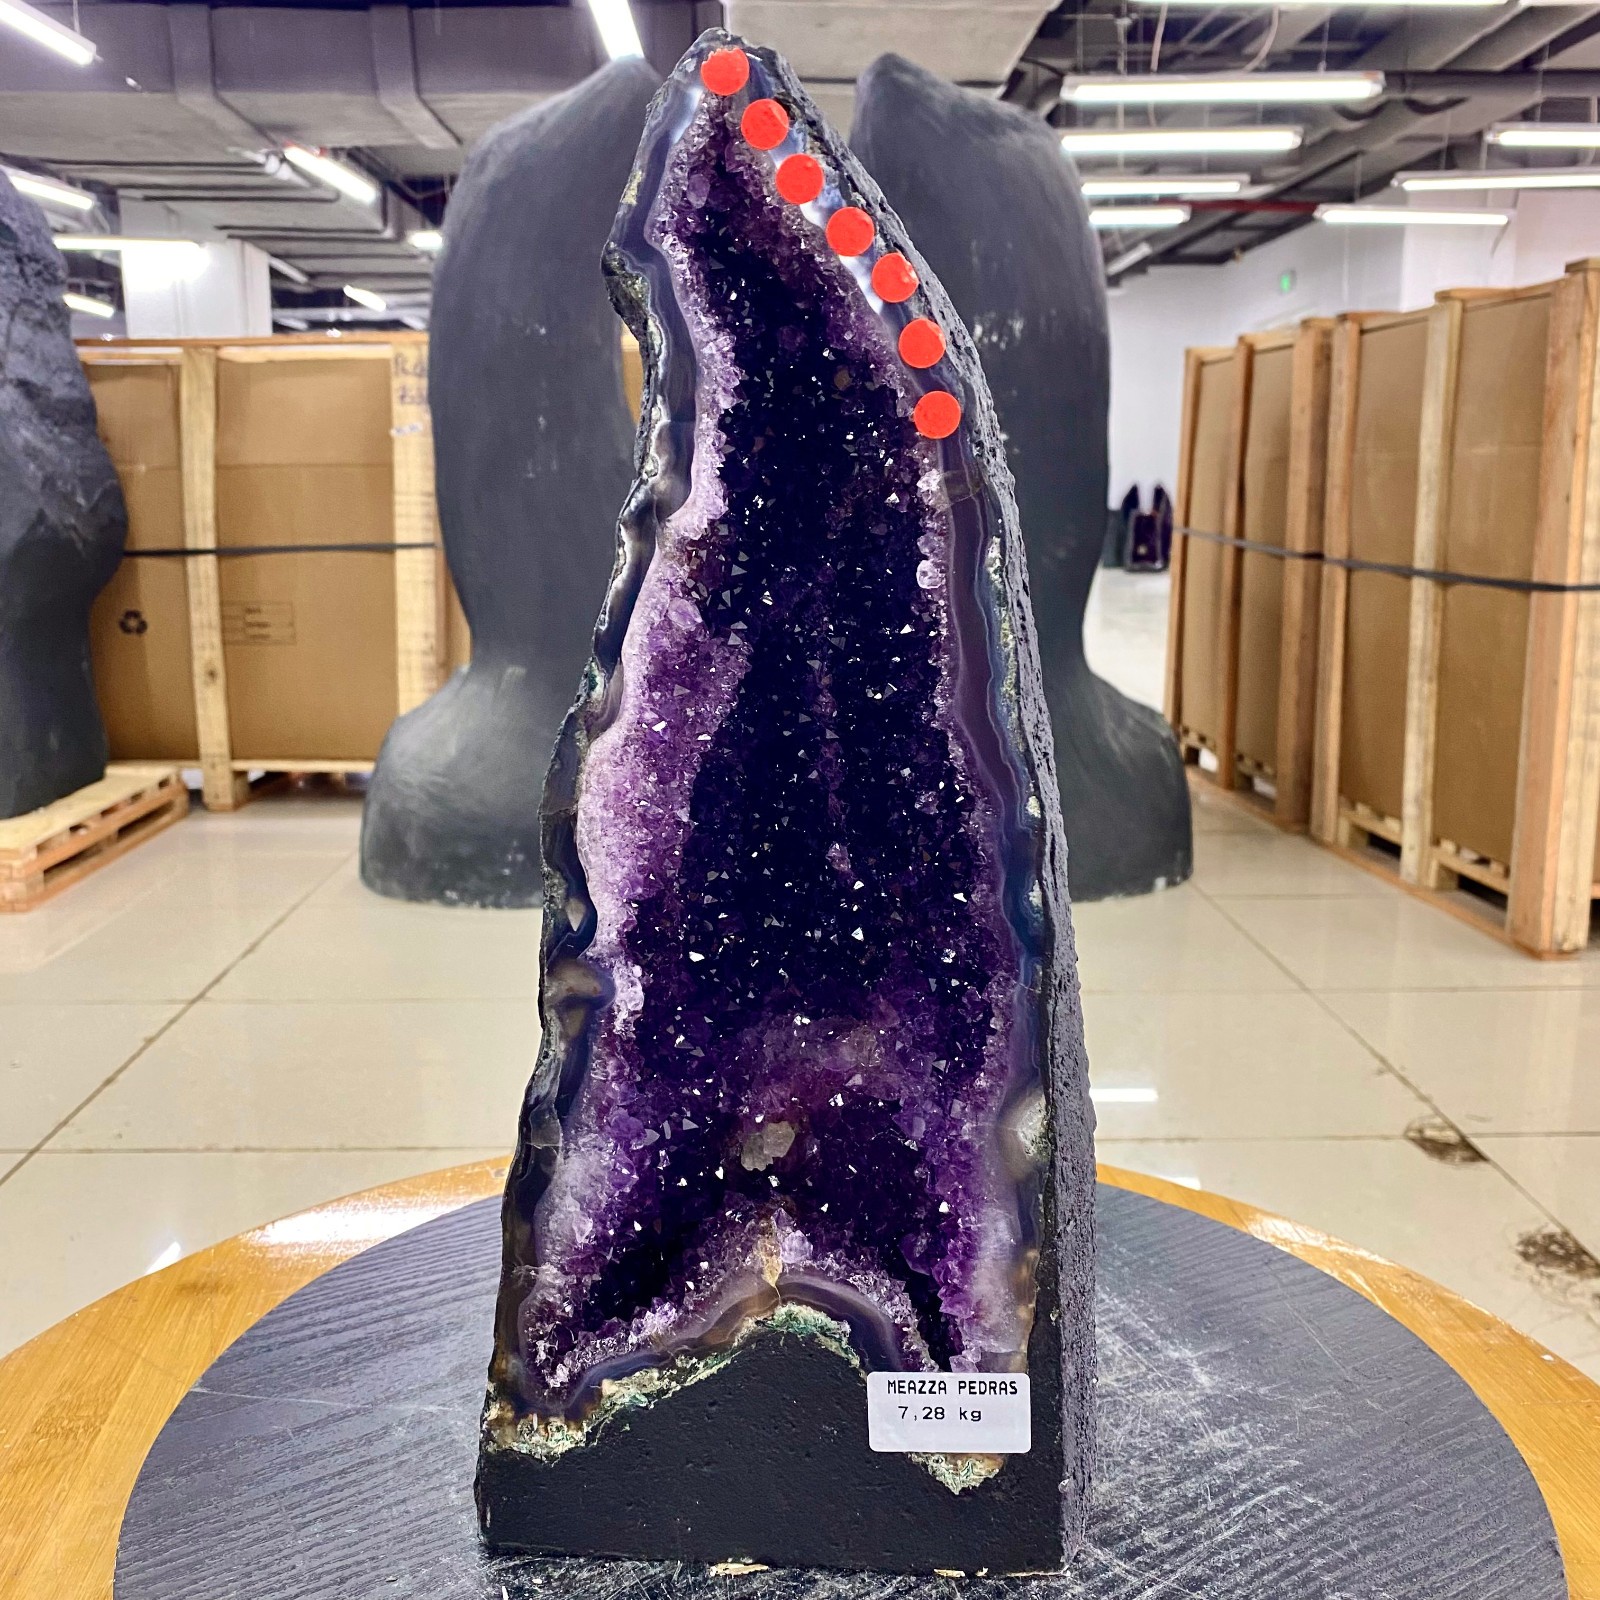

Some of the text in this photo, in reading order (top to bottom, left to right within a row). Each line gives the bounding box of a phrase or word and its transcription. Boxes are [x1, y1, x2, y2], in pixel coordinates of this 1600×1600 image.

[887, 1379, 1018, 1395] MEAZZA PEDRAS
[897, 1405, 982, 1422] 7,28 kg
